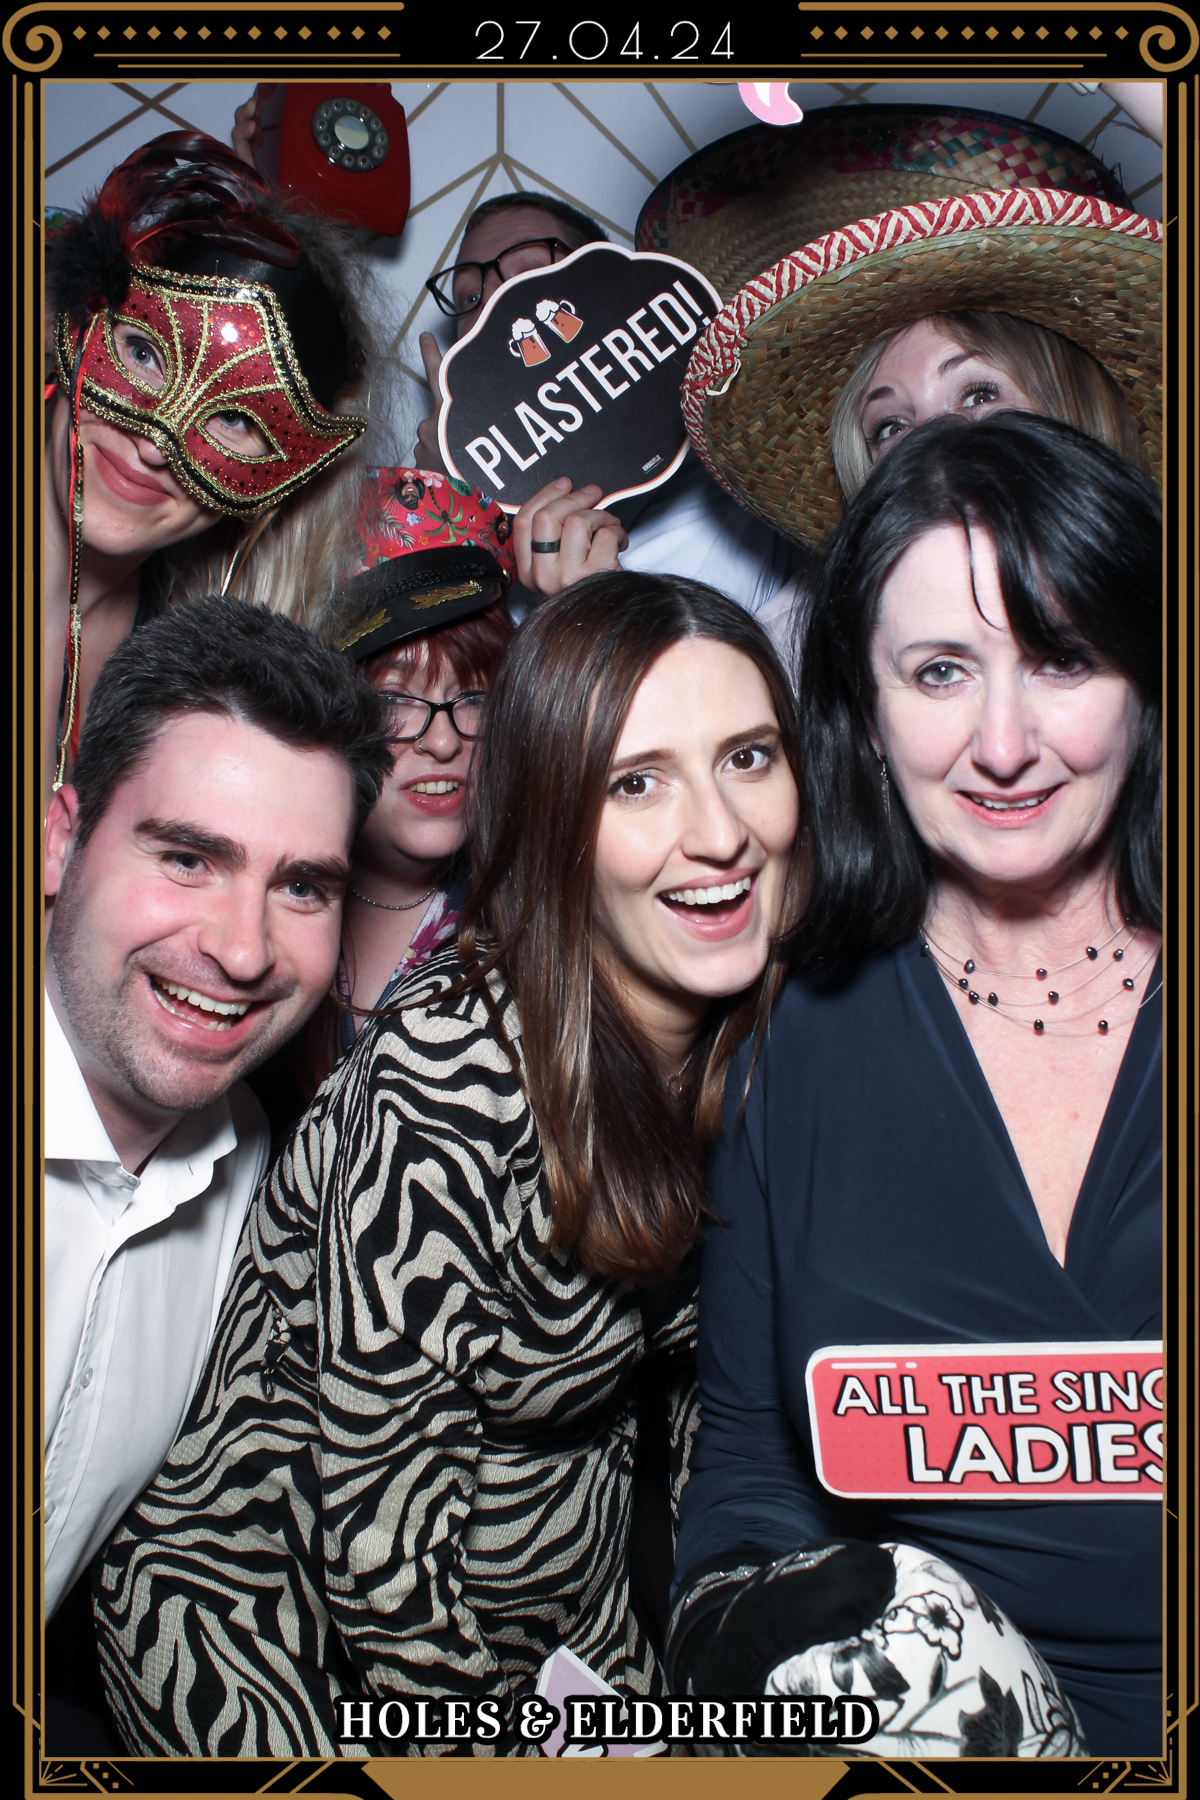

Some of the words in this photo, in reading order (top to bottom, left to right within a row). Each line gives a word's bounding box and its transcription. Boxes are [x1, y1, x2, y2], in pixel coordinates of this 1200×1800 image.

[464, 280, 712, 491] PLASTERED!
[834, 1374, 927, 1416] ALL
[939, 1371, 1038, 1415] THE
